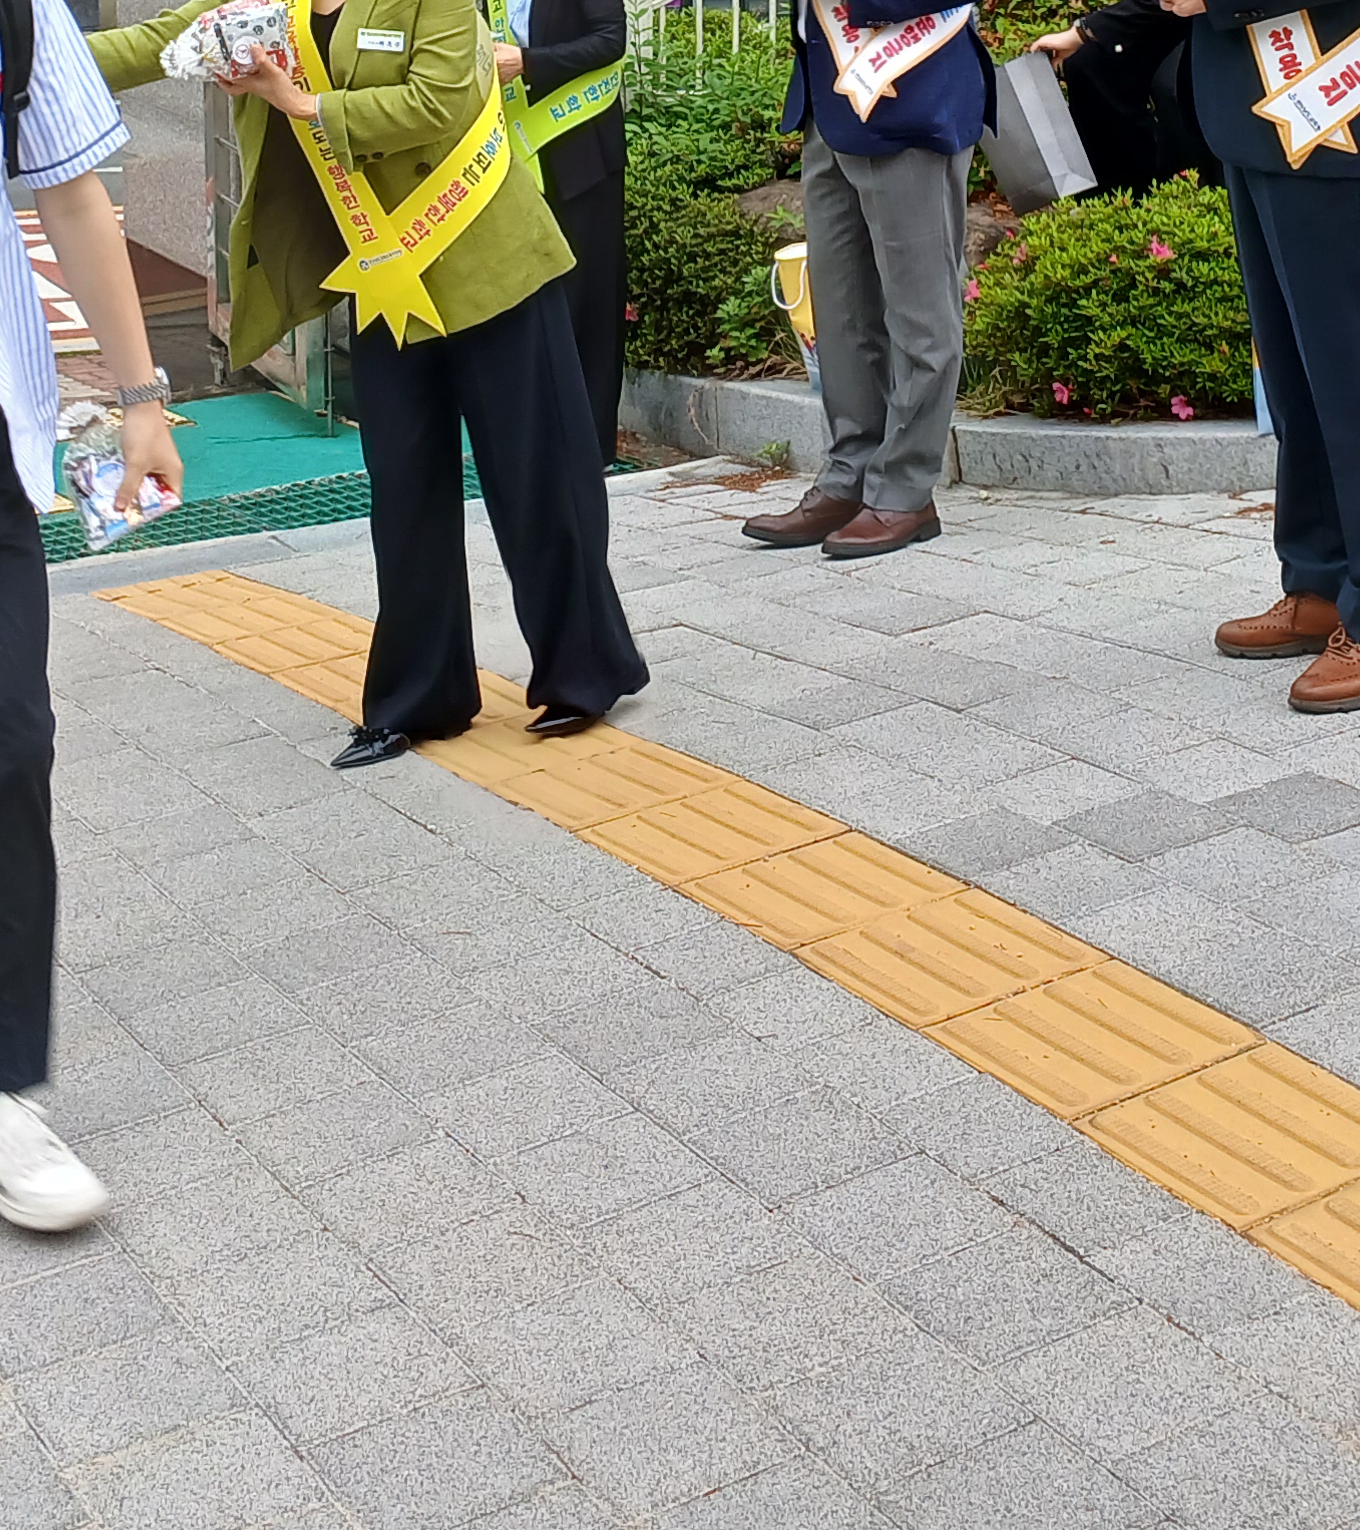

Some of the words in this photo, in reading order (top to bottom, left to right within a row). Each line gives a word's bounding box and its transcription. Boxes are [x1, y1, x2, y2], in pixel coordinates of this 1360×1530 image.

[549, 92, 580, 122] 학교
[424, 179, 469, 226] 행복한
[349, 212, 379, 244] 학교
[398, 218, 432, 253] 학교
